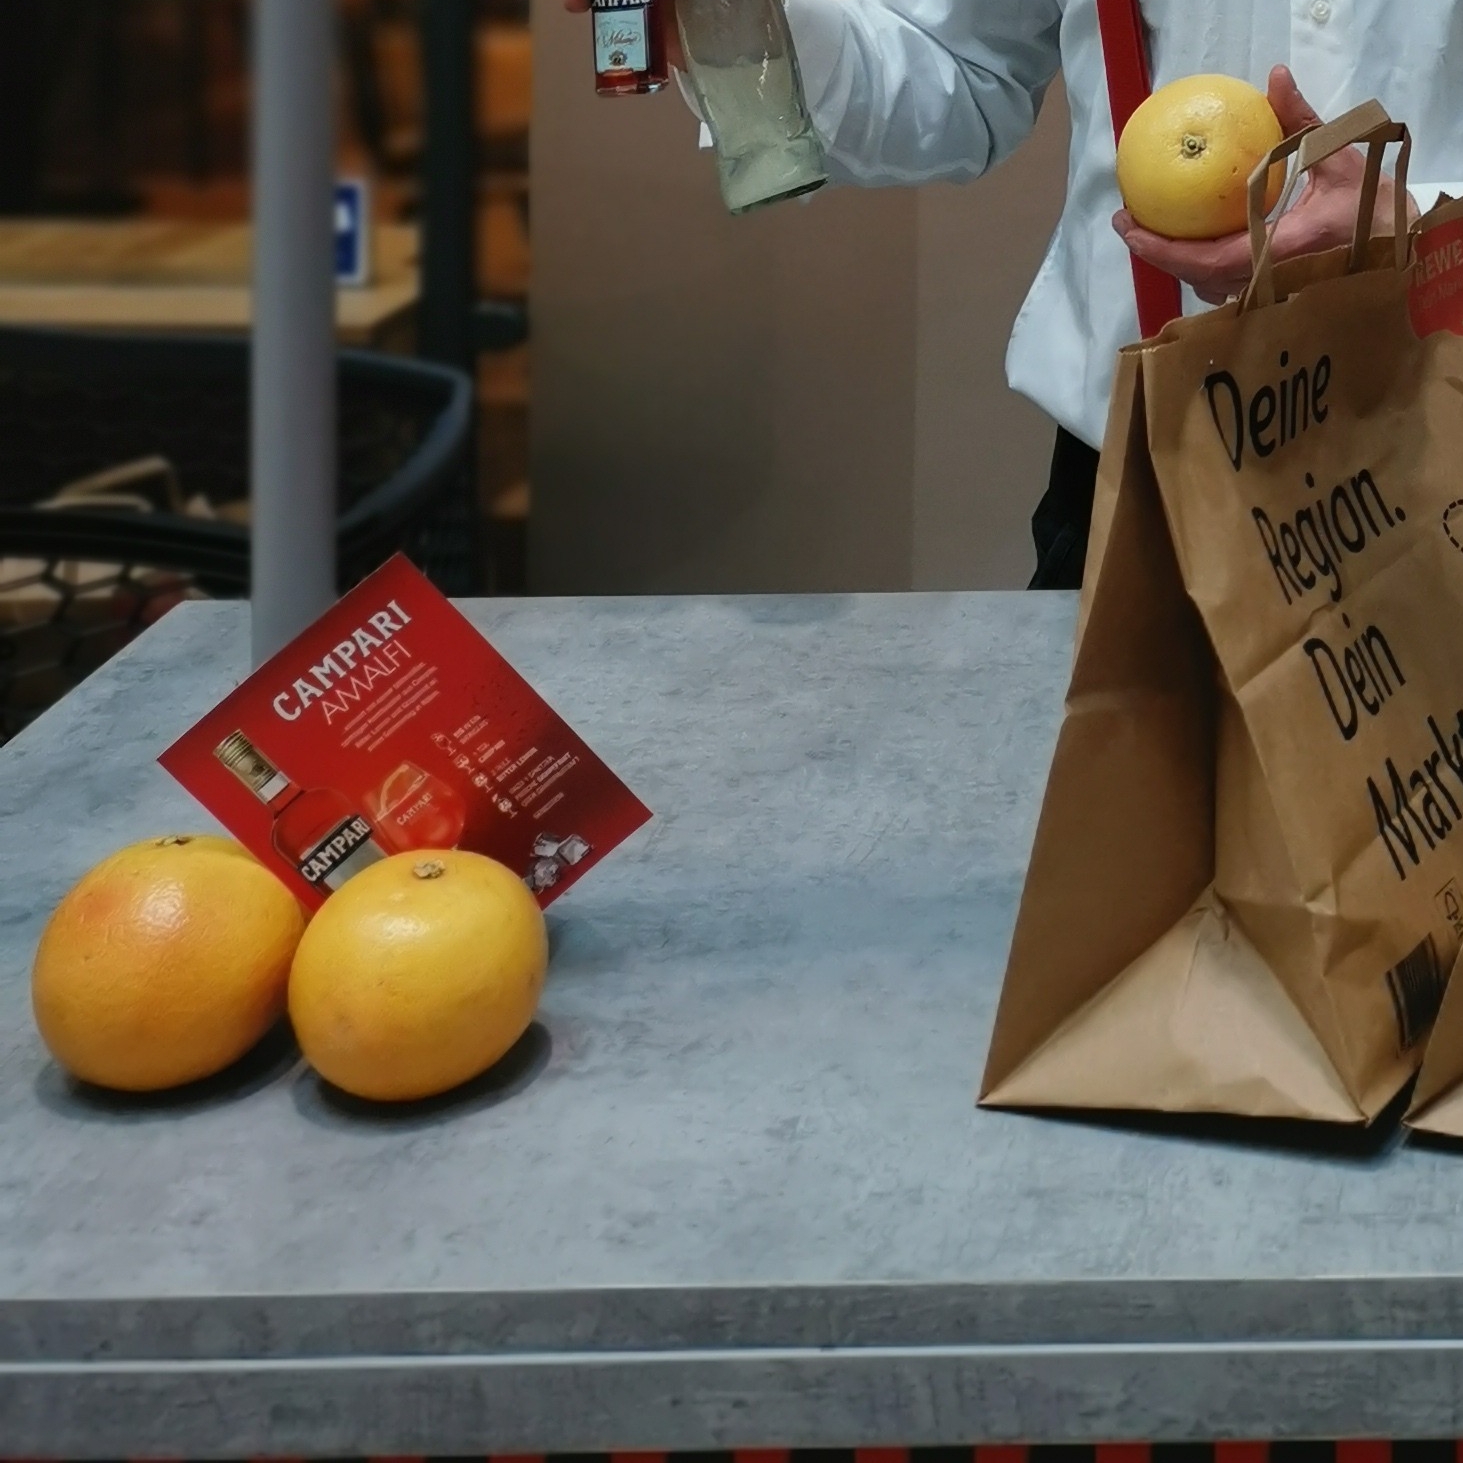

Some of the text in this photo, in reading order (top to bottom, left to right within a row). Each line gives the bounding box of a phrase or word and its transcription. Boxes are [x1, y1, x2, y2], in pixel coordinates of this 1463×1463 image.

[1204, 350, 1331, 472] Deine
[1251, 469, 1406, 606] Region.
[272, 599, 412, 721] CAMPARI
[321, 639, 412, 725] AMALFI
[1303, 612, 1406, 741] Dein
[301, 817, 371, 882] CAMPARI
